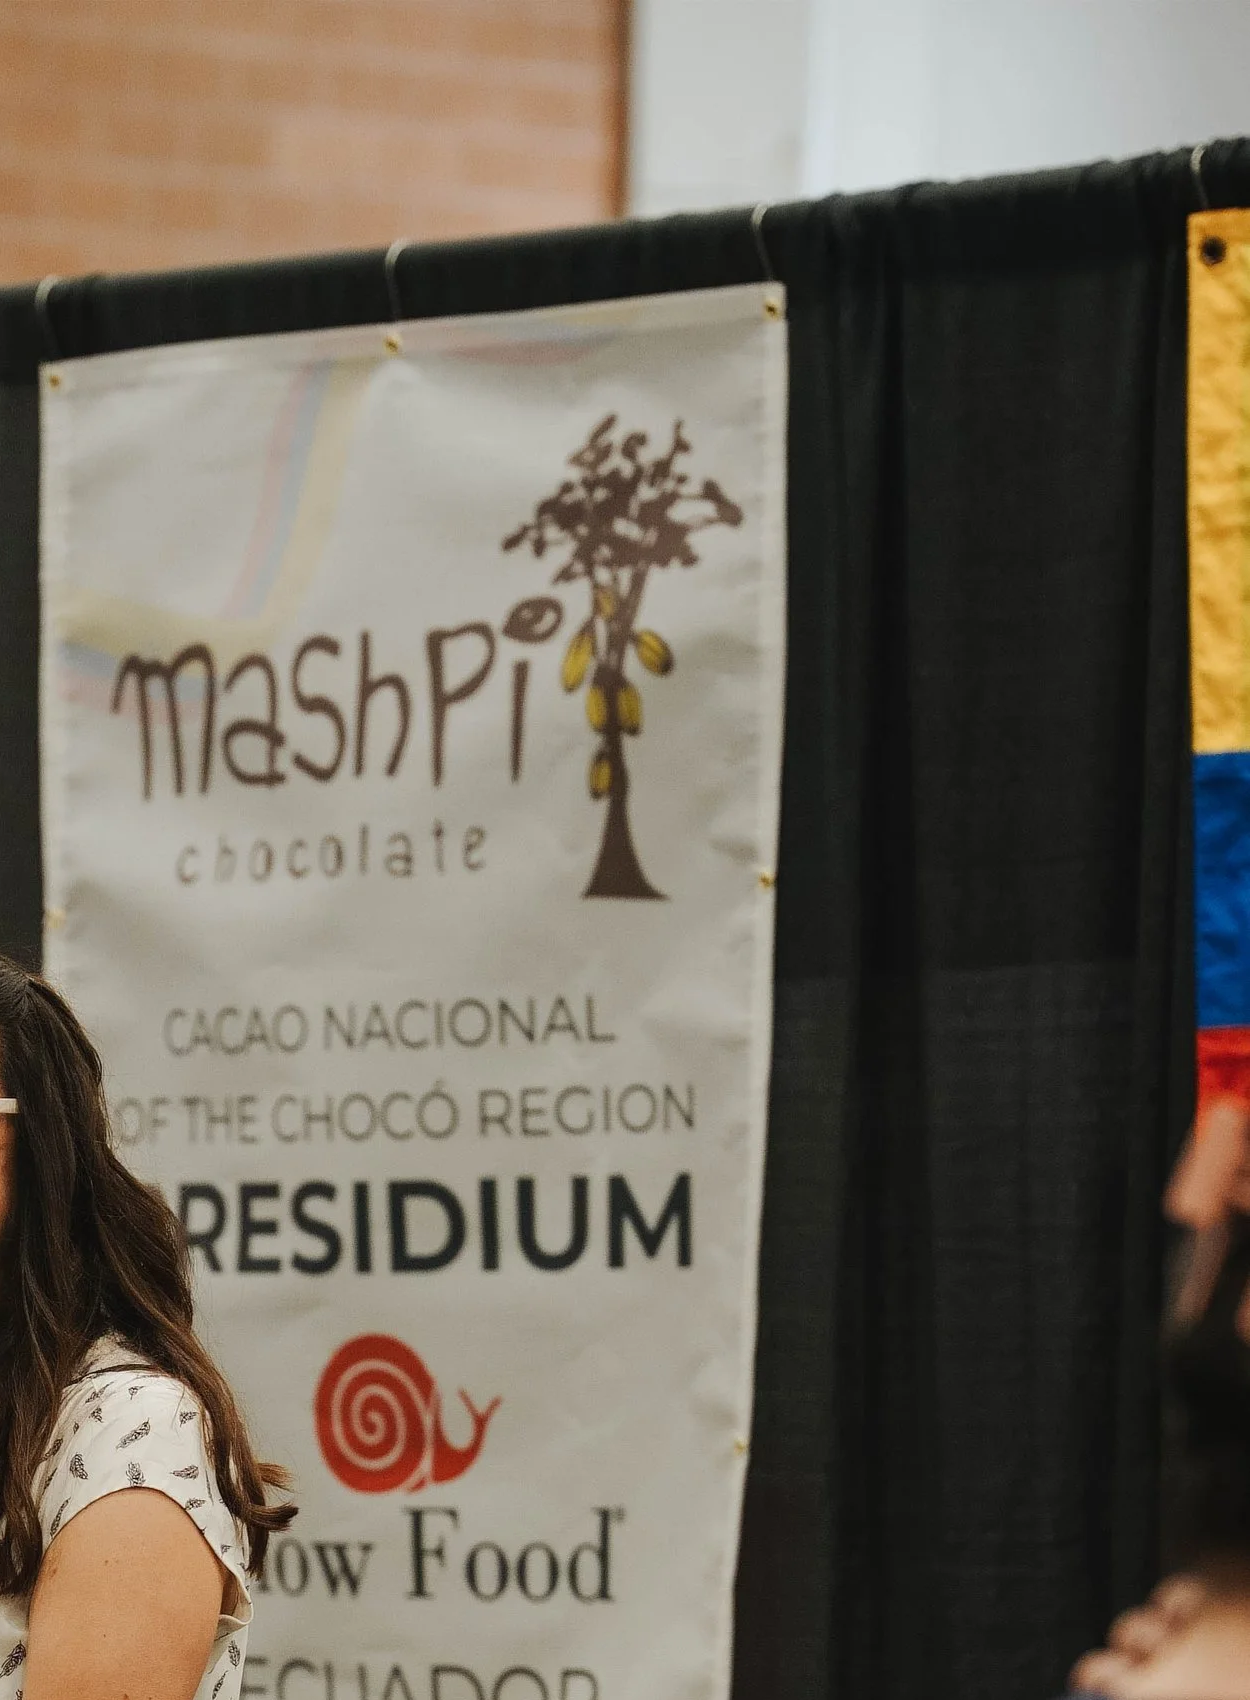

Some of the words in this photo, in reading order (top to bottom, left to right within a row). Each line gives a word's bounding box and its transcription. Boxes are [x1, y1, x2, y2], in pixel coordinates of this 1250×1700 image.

[175, 819, 488, 885] chocolate
[162, 1004, 309, 1058] CACAO
[322, 995, 616, 1053] NACIONAL
[116, 1096, 170, 1147] OF
[183, 1095, 259, 1146] THE
[270, 1079, 460, 1145] CHOCÓ
[478, 1082, 697, 1139] REGION
[178, 1171, 692, 1277] RESIDIUM
[402, 1504, 616, 1604] Food
